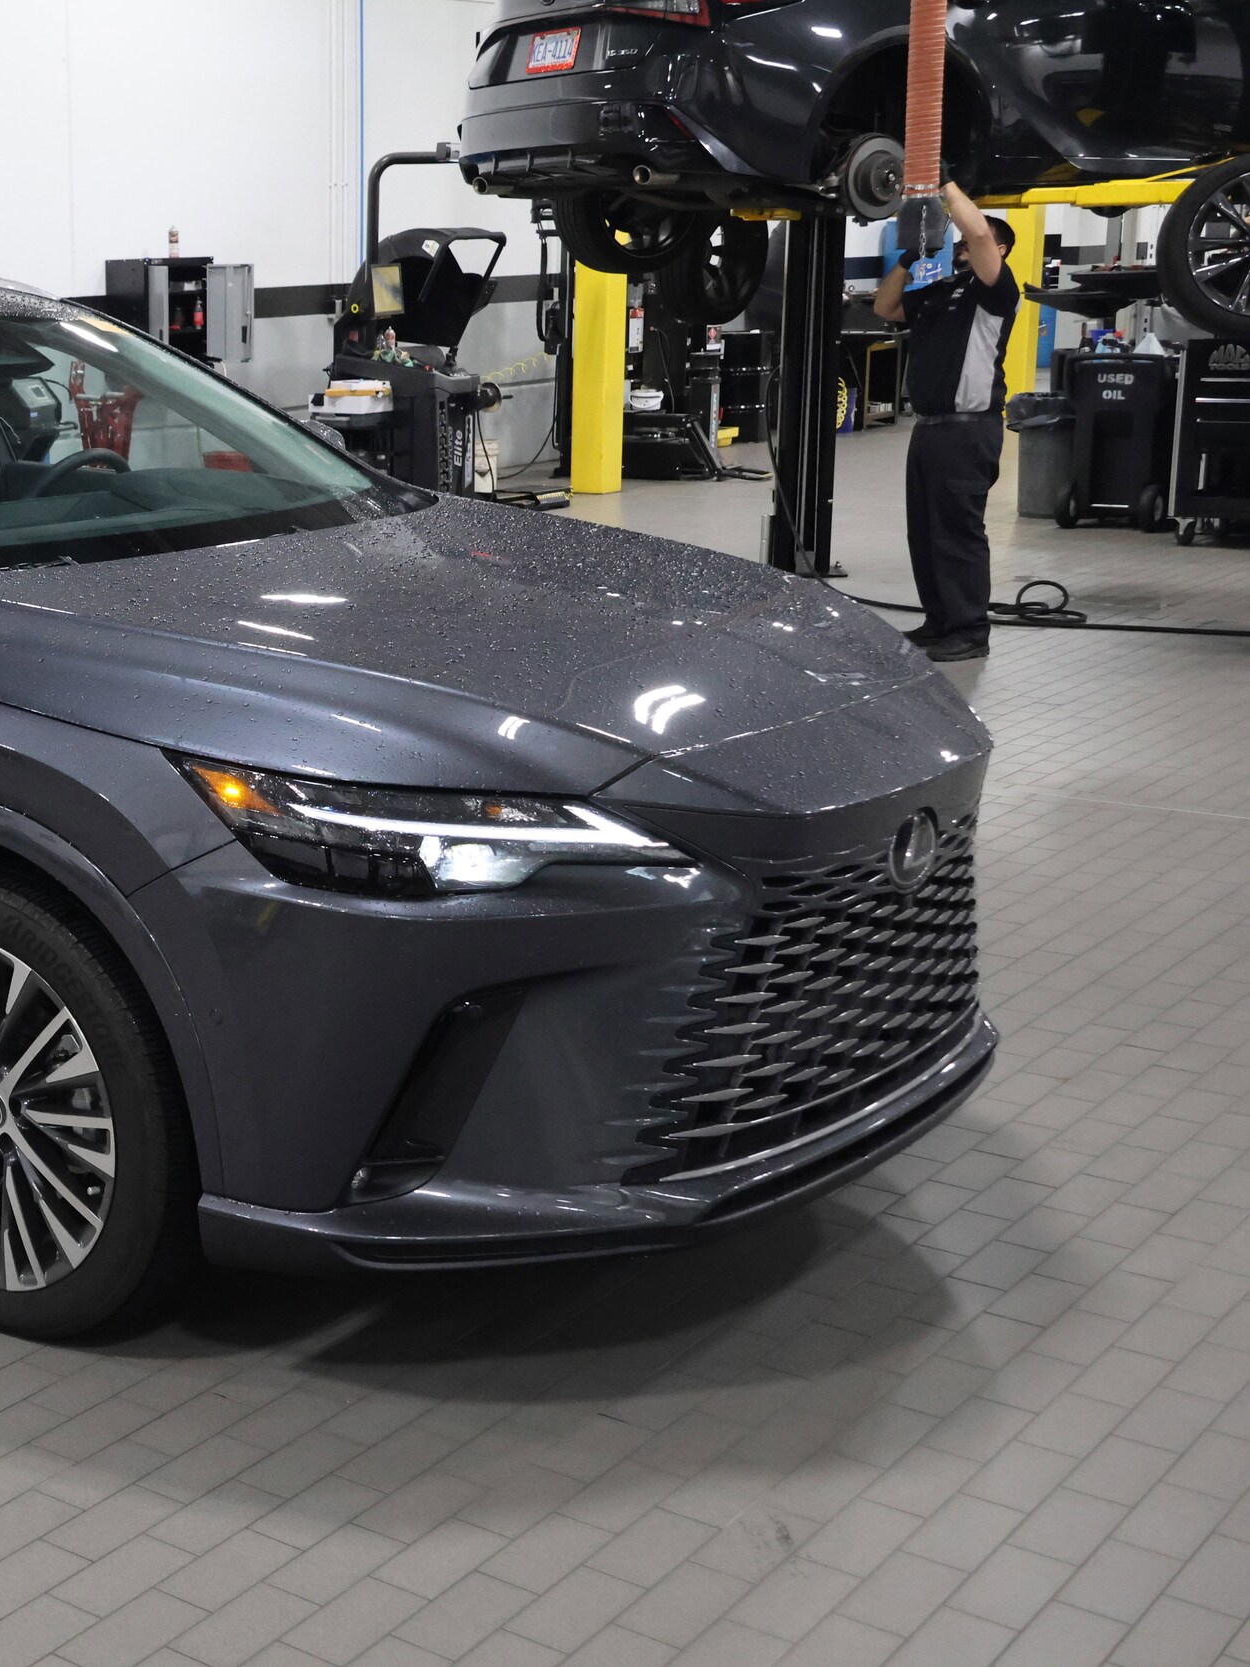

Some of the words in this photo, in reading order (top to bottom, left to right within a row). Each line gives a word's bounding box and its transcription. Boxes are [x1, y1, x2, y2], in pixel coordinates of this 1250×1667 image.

[1097, 373, 1135, 385] USED
[1102, 389, 1126, 400] OIL
[453, 429, 463, 467] Elite
